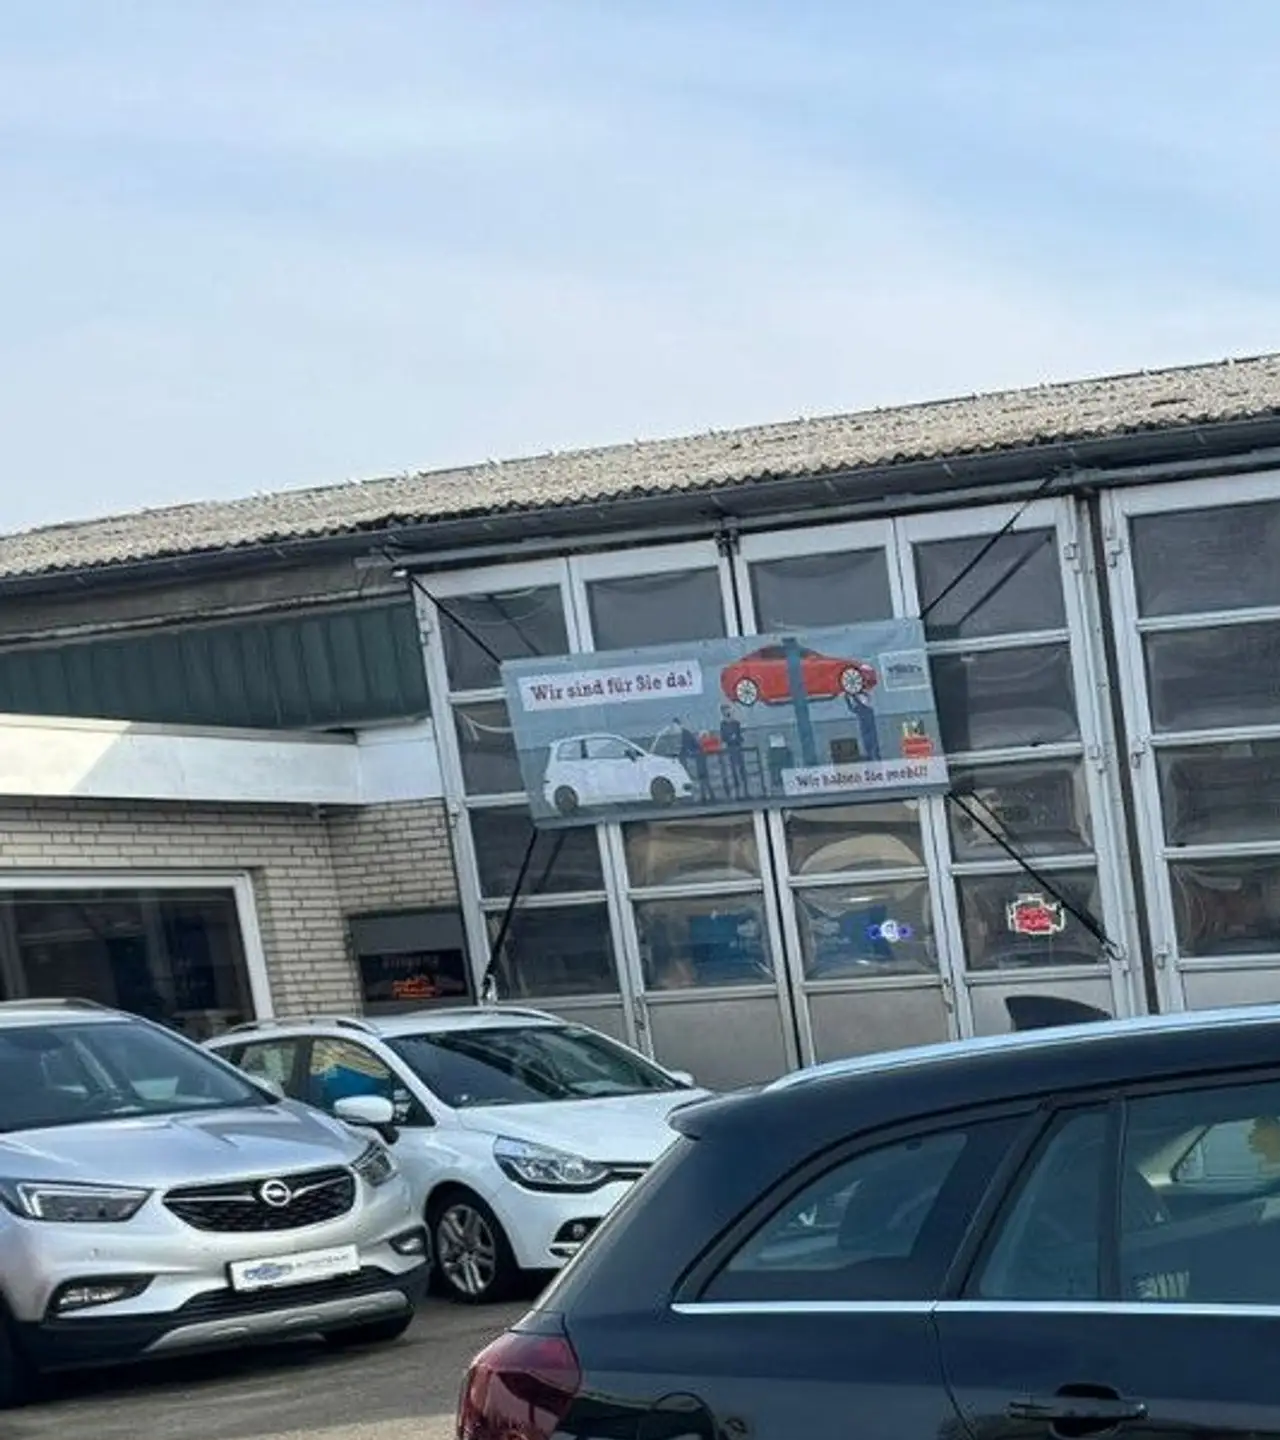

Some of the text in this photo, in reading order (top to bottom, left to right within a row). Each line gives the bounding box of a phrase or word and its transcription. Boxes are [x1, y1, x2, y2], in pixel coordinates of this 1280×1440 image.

[530, 669, 693, 701] Wir sind für Sie da!
